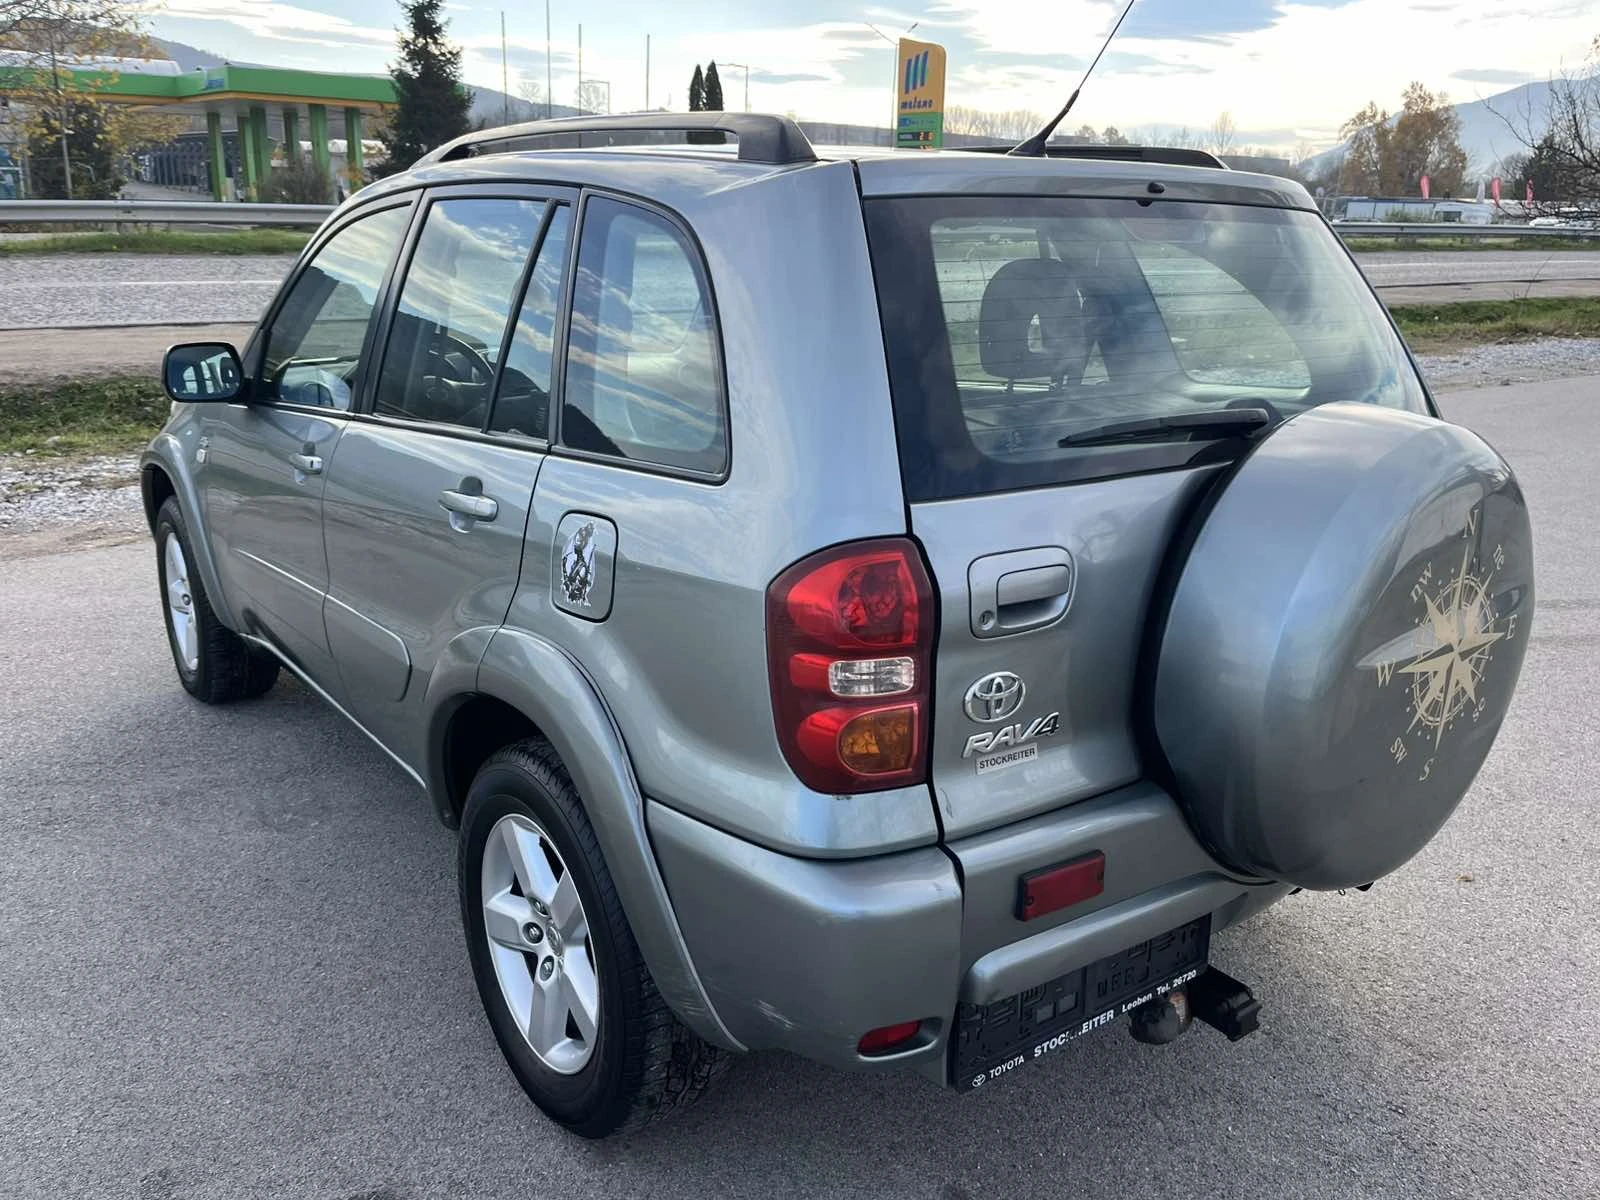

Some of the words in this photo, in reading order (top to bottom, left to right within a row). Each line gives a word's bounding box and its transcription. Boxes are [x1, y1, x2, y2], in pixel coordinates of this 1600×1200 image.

[1463, 510, 1479, 538] N
[1506, 614, 1519, 640] E
[1375, 659, 1397, 689] W
[961, 711, 1060, 759] RAV4
[979, 747, 1036, 769] STOCKREITER
[1418, 757, 1435, 782] S
[989, 1055, 1025, 1079] TOYOTA
[1033, 1009, 1115, 1058] STOCEITER
[1156, 983, 1171, 996] Tel.
